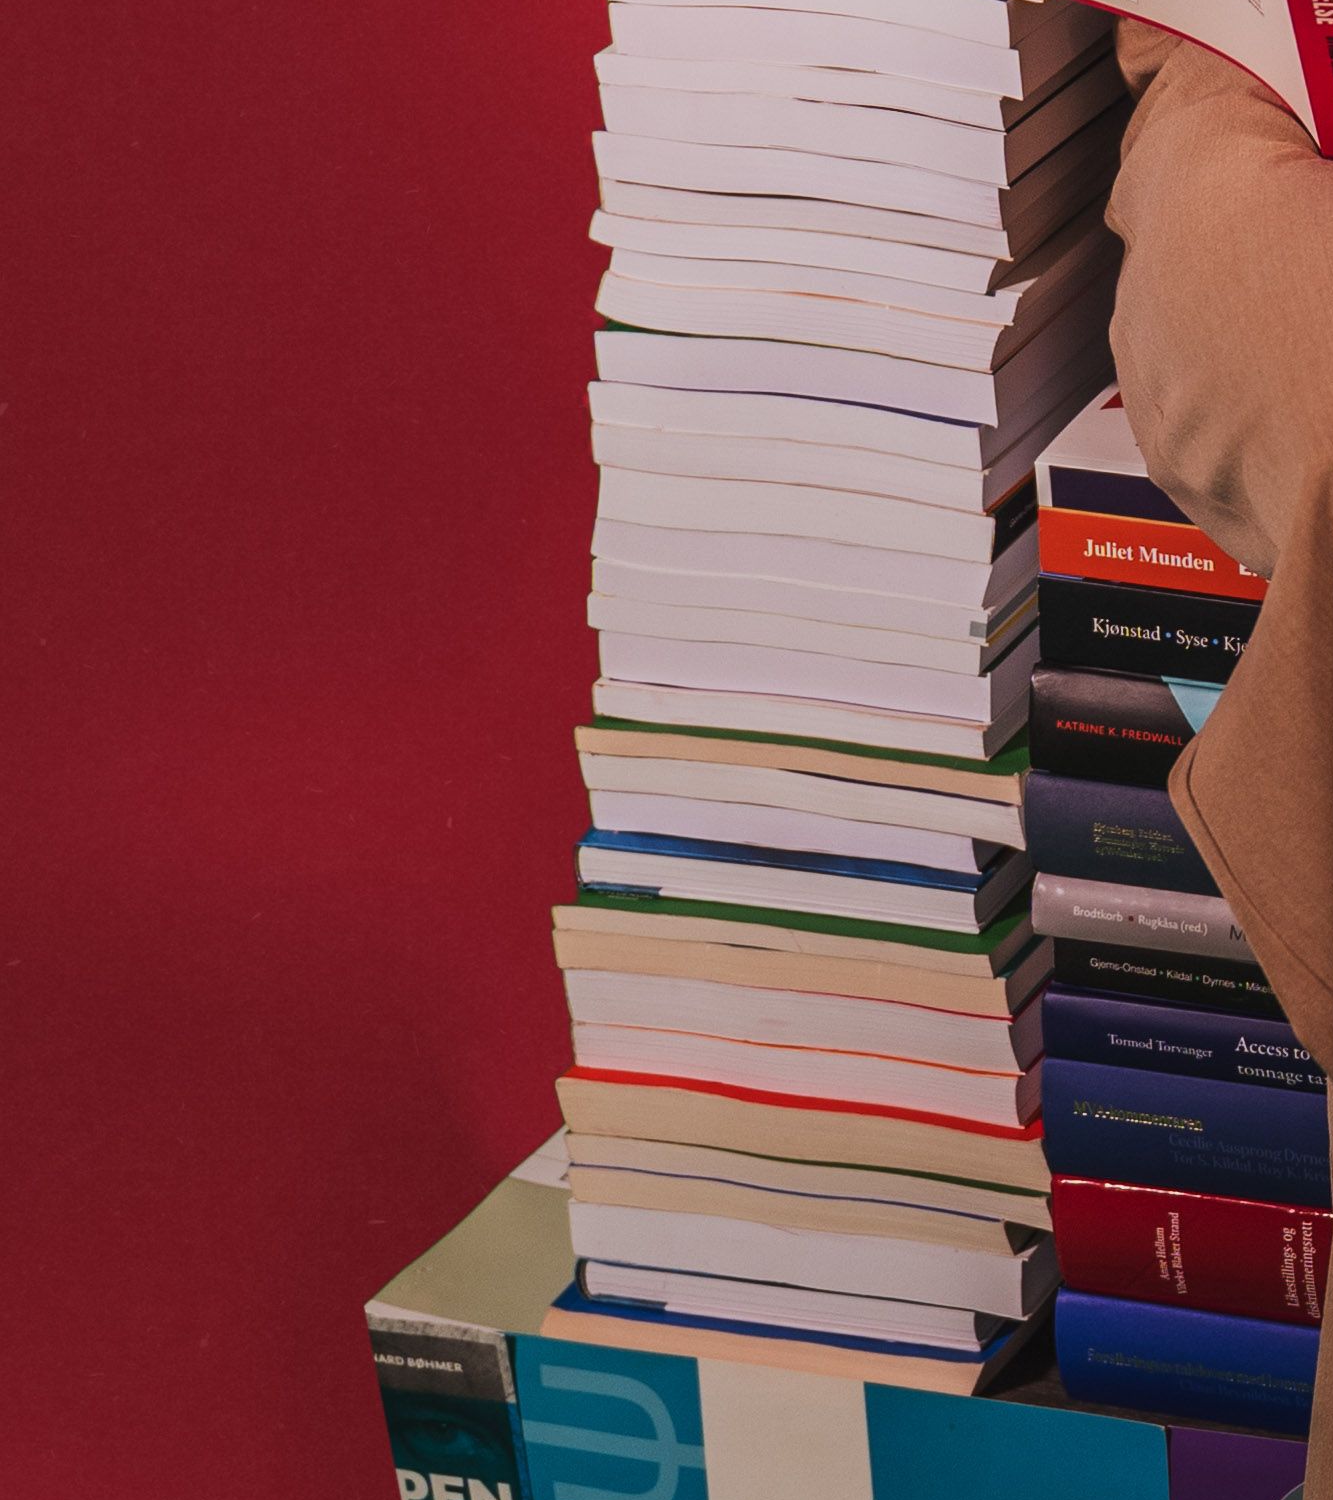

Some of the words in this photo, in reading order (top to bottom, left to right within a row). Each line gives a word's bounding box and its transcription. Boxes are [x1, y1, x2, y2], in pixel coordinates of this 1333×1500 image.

[1083, 537, 1134, 563] Juliet
[1138, 545, 1214, 574] Munden
[1091, 616, 1162, 645] Kjønstad
[1175, 628, 1209, 652] Syse
[1222, 635, 1252, 657] Kje
[1056, 718, 1105, 737] KATRINE
[1107, 726, 1119, 739] K.
[1121, 728, 1184, 747] FREDWALL
[1072, 905, 1123, 923] Brodtkorb
[1137, 914, 1178, 931] Rugkåsa
[1180, 919, 1208, 937] (red.)
[1089, 957, 1157, 977] Gjems-Onstad
[1165, 968, 1194, 983] Kildal
[1202, 974, 1237, 990] Dyrnes
[1106, 1031, 1154, 1051] Tormod
[1155, 1038, 1214, 1061] Torvanger
[1233, 1035, 1290, 1058] Access
[1293, 1045, 1311, 1062] to
[1236, 1063, 1302, 1087] tonnage
[1155, 1226, 1166, 1260] Hellum
[1167, 1211, 1180, 1243] Strand
[1280, 1243, 1300, 1308] Likestillings-
[1300, 1220, 1322, 1319] diskrimineringsrett
[406, 1356, 464, 1374] BØHMER
